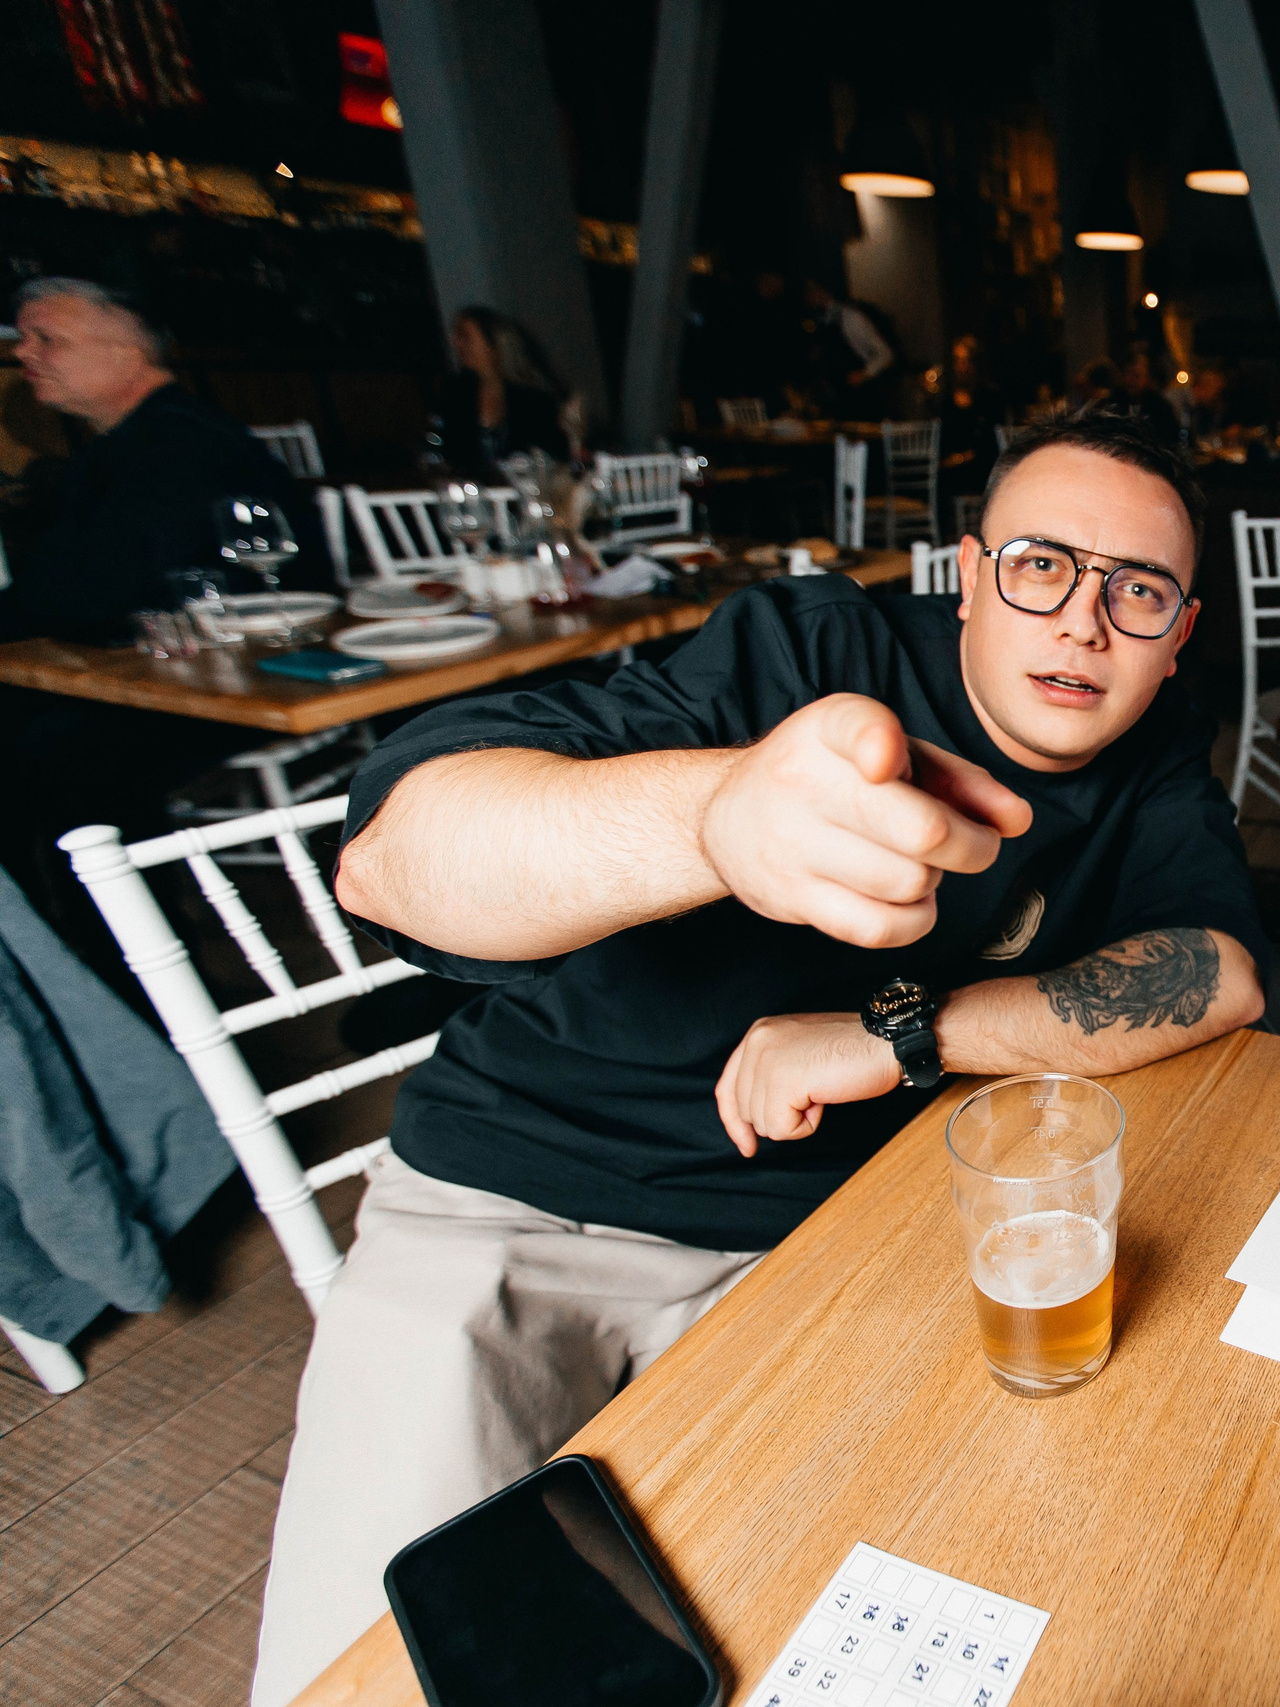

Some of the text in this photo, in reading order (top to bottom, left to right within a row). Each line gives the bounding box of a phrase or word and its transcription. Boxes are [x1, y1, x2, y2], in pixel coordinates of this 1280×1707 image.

[835, 1592, 851, 1610] 17
[891, 1614, 909, 1633] 18
[962, 1612, 996, 1660] 1 10
[816, 1603, 881, 1690] 16 23 32
[911, 1630, 949, 1682] 13 21
[787, 1657, 807, 1678] 39
